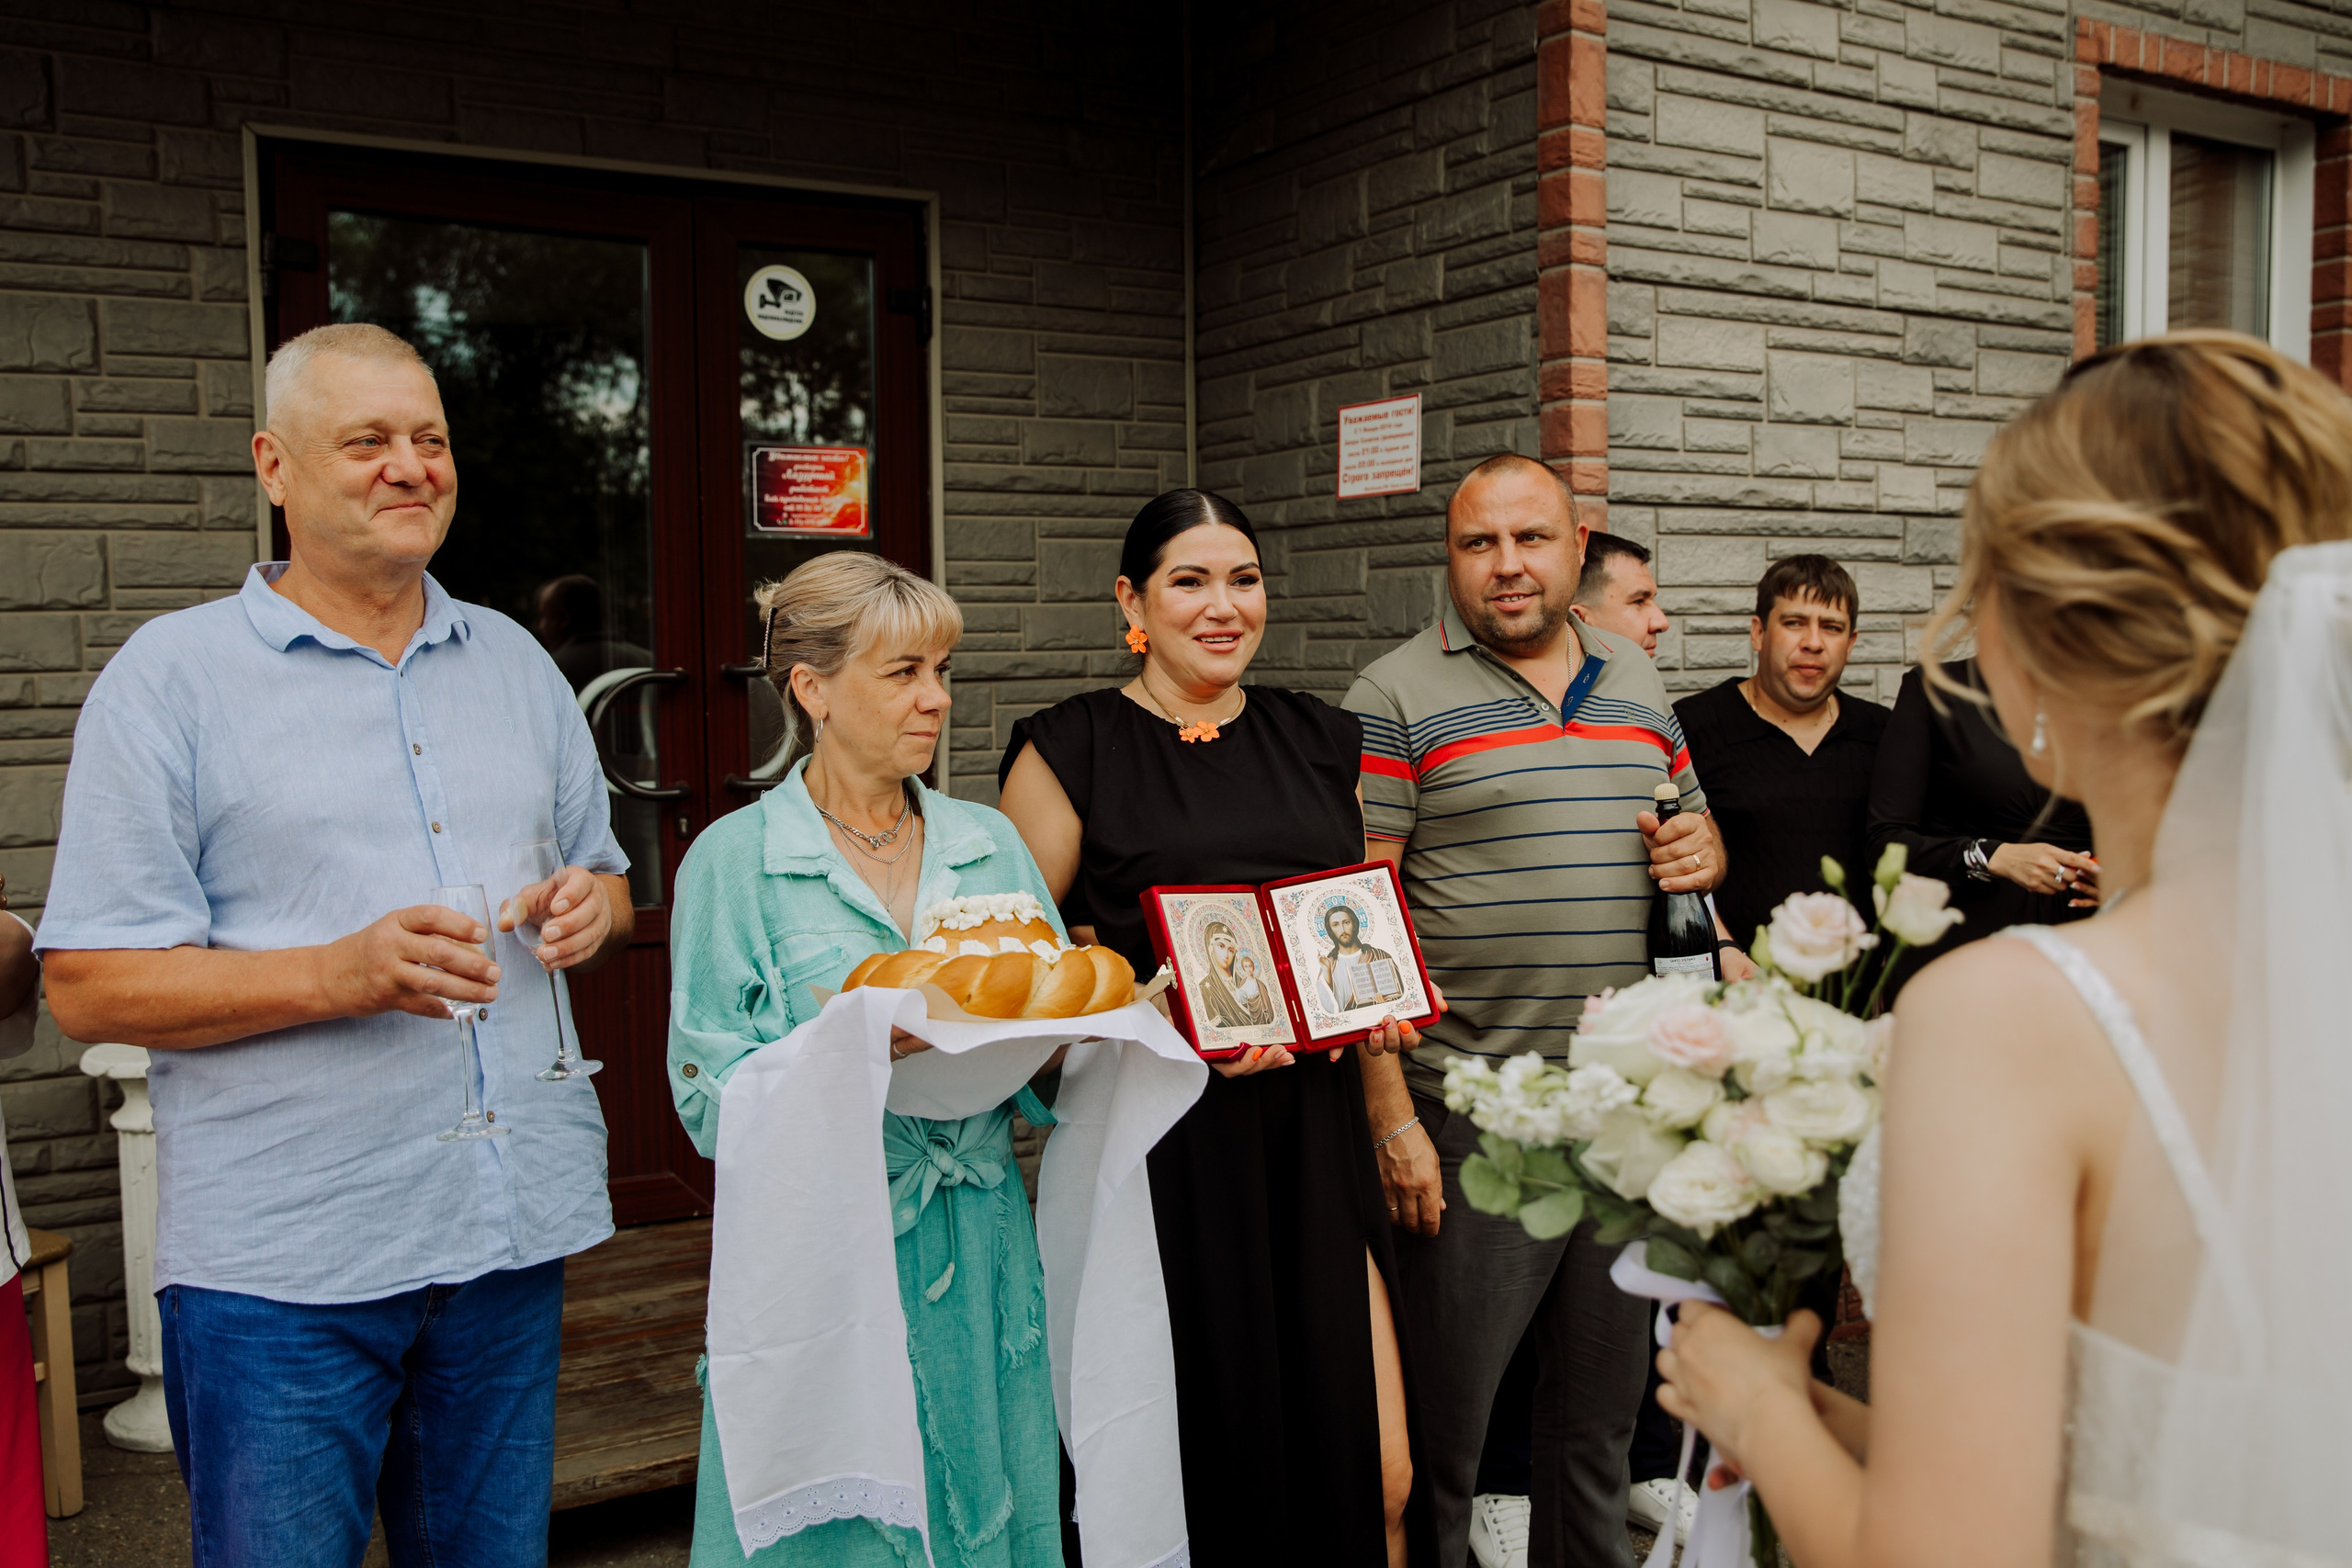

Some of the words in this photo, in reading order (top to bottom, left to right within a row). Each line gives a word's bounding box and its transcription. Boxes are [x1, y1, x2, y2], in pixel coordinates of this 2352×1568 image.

[1343, 412, 1388, 424] Уважаемые
[1391, 405, 1415, 417] гости!
[1362, 446, 1379, 456] 21:00
[781, 468, 835, 483] Лазурный
[1342, 472, 1369, 485] Строго
